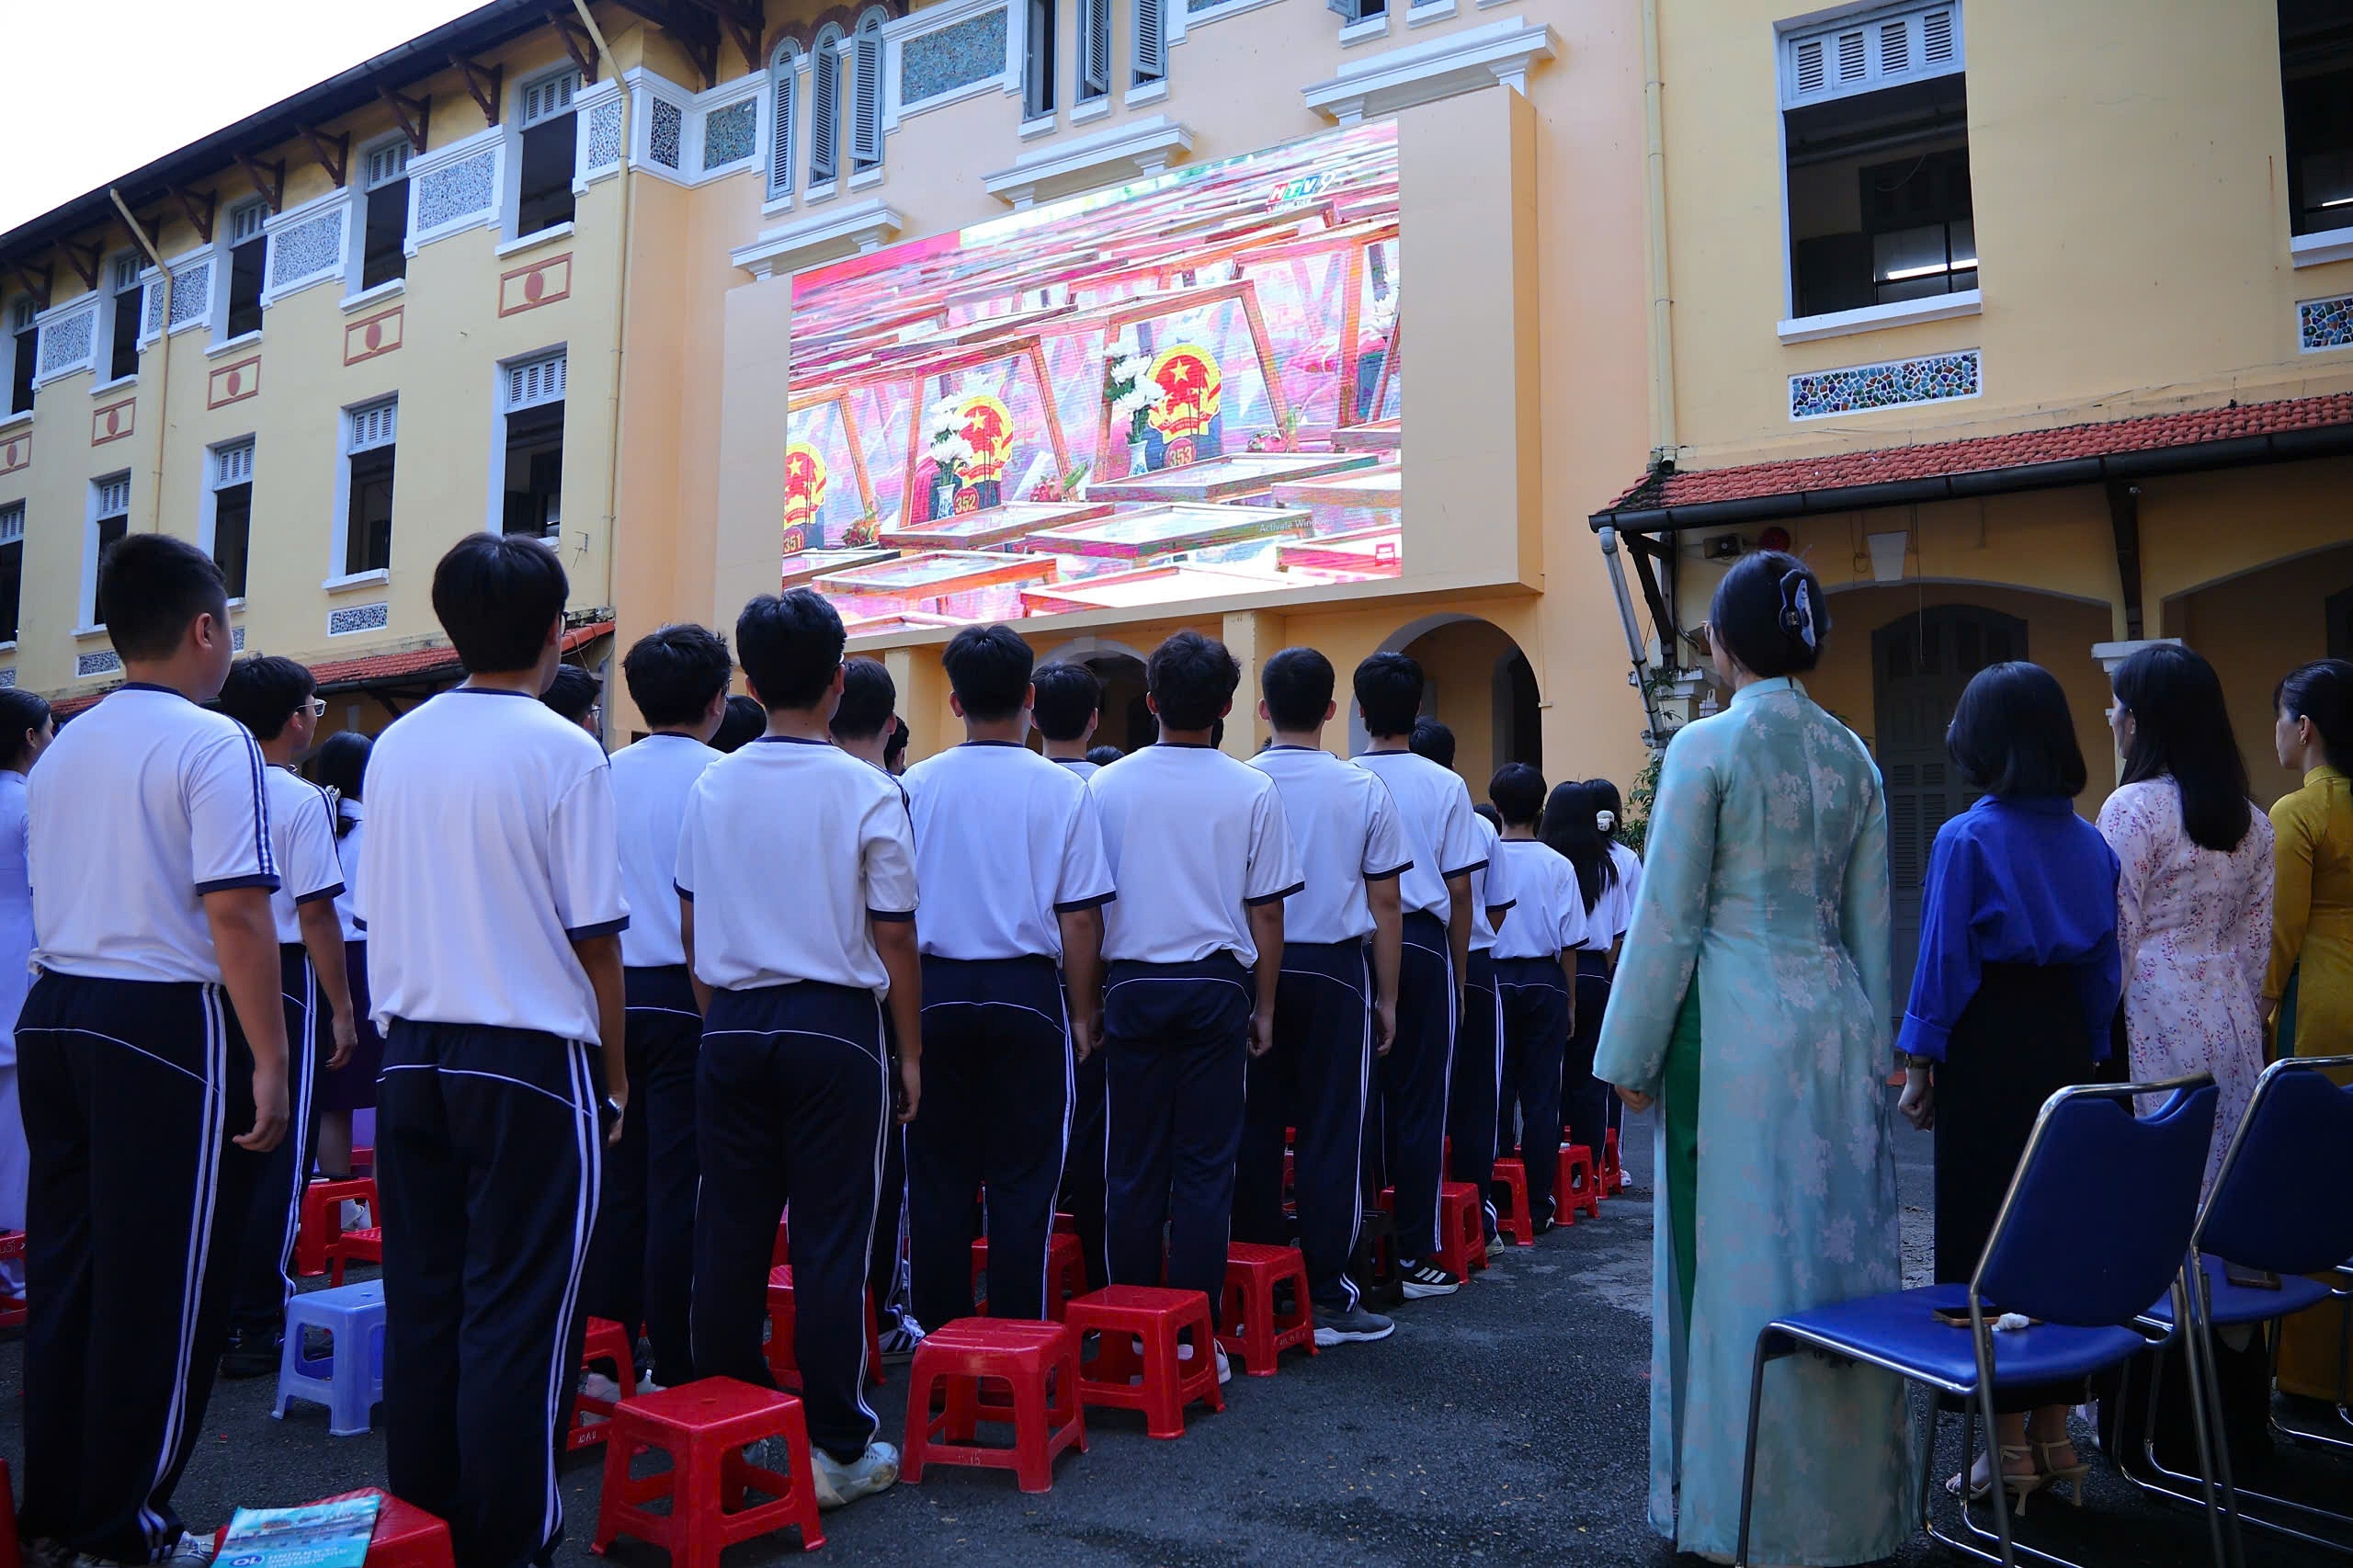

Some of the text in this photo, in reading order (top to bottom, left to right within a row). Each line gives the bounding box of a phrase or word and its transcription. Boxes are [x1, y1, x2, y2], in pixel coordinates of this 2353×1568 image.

[1268, 172, 1336, 202] HTV9
[1169, 446, 1192, 467] 353
[956, 494, 976, 514] 352
[1259, 520, 1293, 533] Activate
[784, 533, 801, 553] 351
